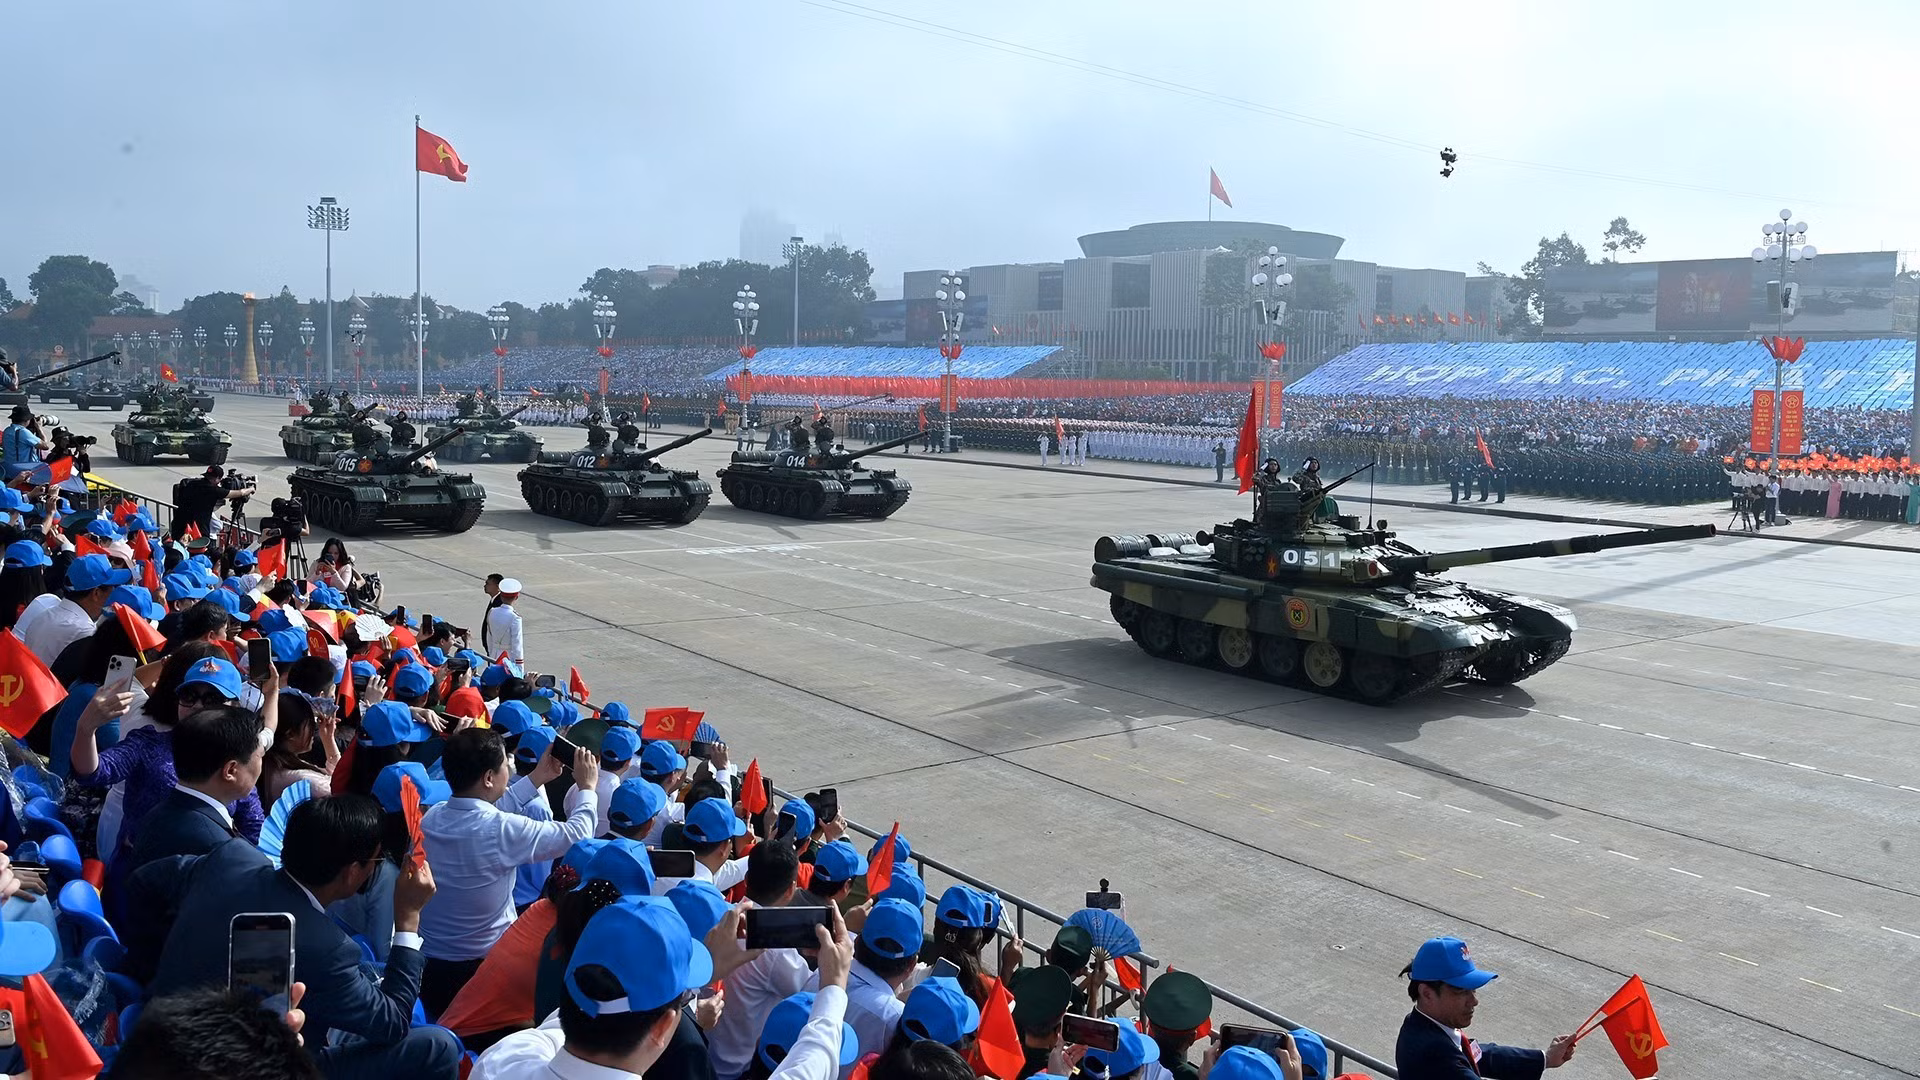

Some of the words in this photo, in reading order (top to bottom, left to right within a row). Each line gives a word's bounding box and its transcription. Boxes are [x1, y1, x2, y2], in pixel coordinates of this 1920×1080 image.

[338, 457, 358, 472] 015
[576, 455, 596, 468] 012
[786, 455, 806, 467] 014
[1283, 549, 1335, 567] 051
